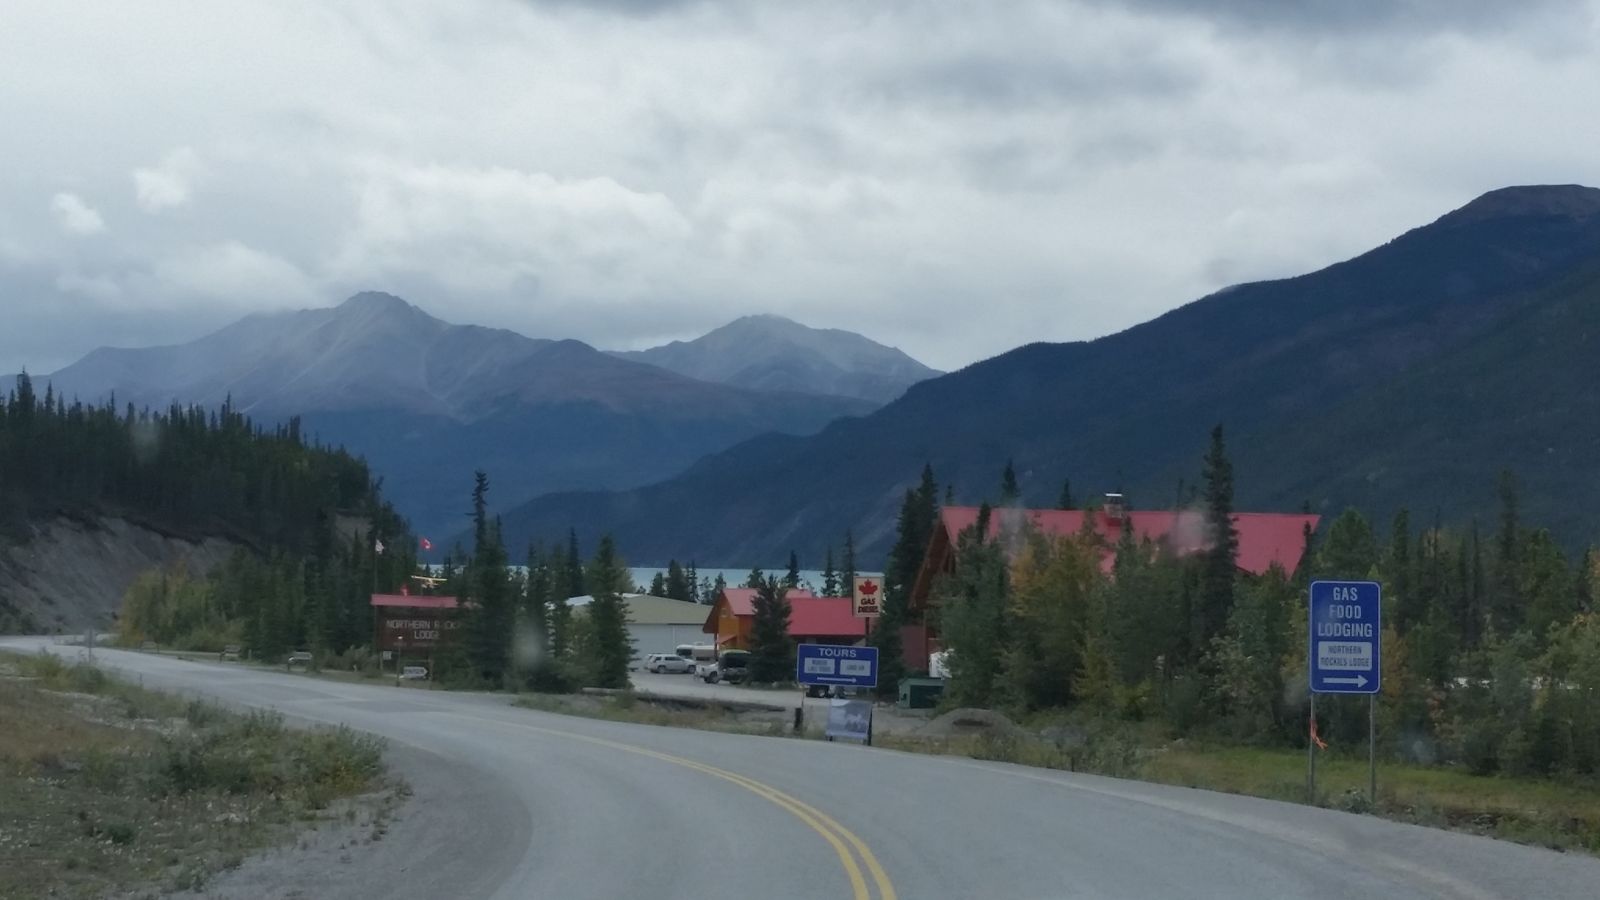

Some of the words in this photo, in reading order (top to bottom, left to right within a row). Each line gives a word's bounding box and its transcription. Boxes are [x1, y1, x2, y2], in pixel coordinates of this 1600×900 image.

[1333, 587, 1358, 601] GAS
[1329, 604, 1361, 619] FOOD
[386, 619, 431, 629] NORTHERN
[1318, 622, 1373, 637] LODGING
[819, 647, 857, 658] TOURS
[1328, 645, 1362, 654] NORTHERN
